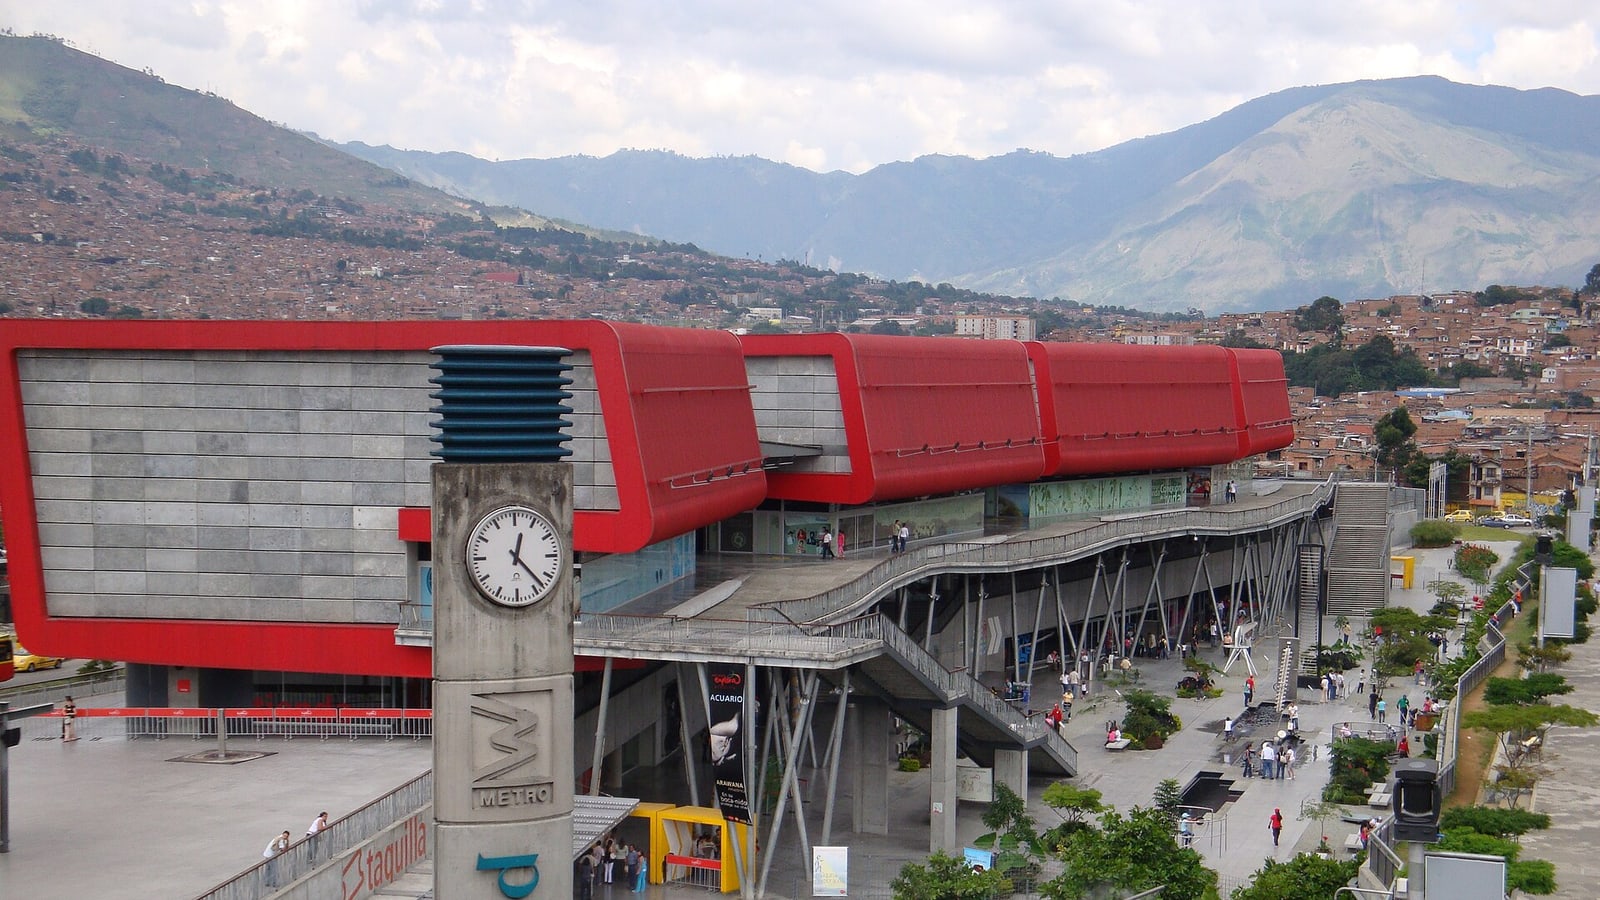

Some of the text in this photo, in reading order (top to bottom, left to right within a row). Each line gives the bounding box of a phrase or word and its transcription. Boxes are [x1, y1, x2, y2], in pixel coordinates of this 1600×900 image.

[710, 694, 743, 703] ACUARIO
[479, 788, 548, 807] METRO
[366, 815, 427, 891] taquilla
